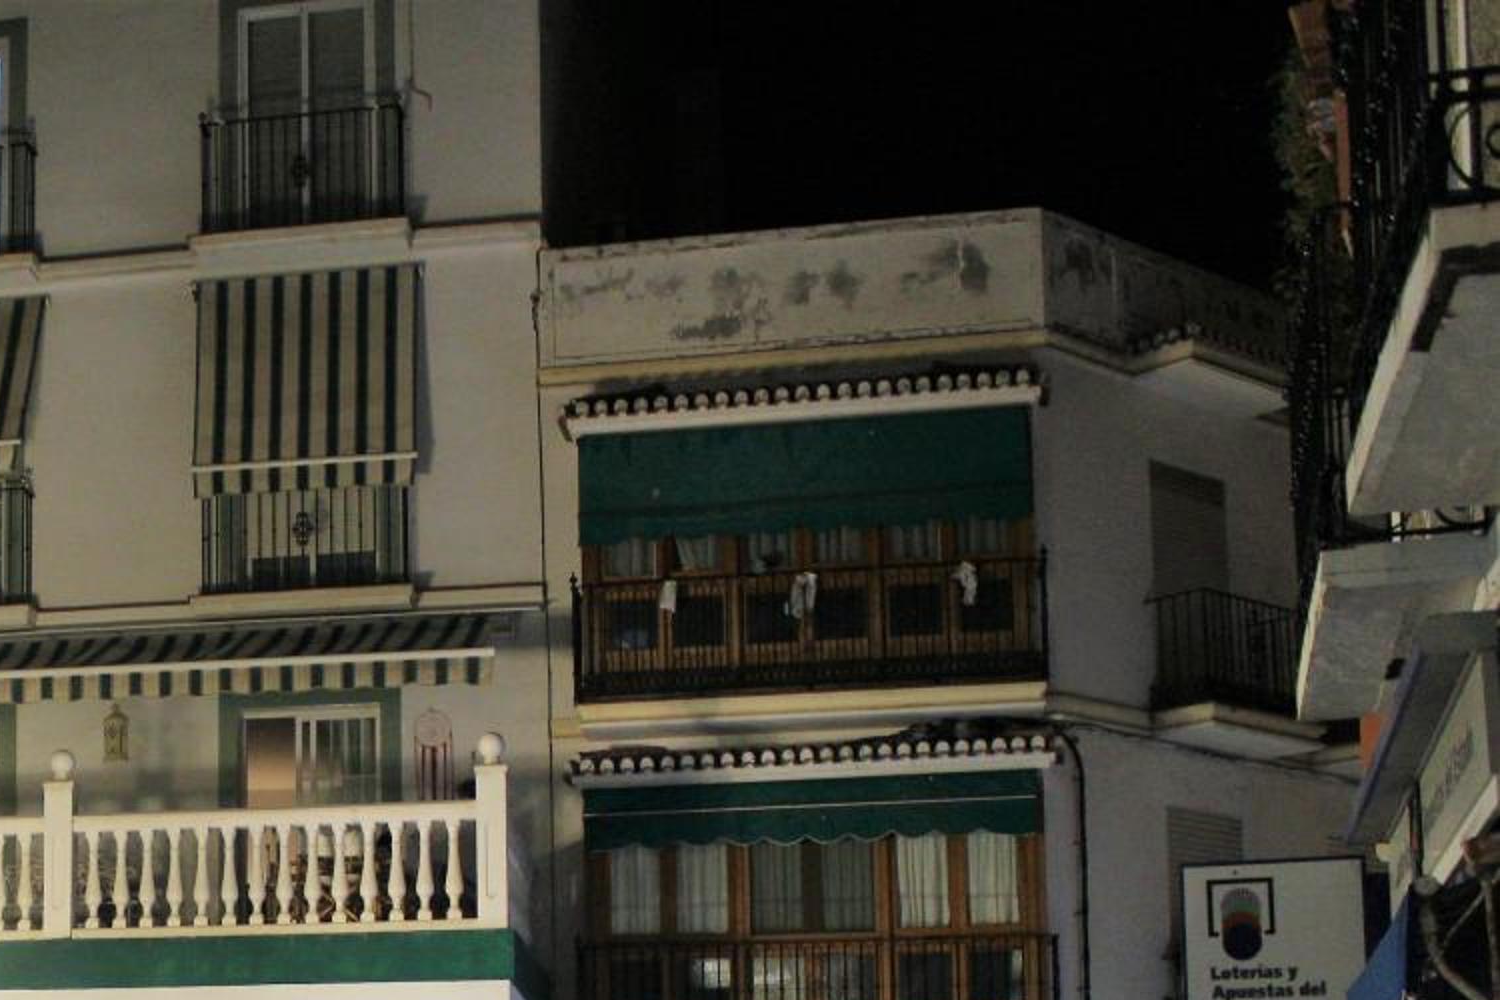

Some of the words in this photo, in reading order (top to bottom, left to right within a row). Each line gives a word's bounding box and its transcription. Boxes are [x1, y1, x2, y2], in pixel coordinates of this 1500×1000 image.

[1288, 966, 1298, 981] y
[1213, 984, 1294, 1000] Apuestas
[1299, 980, 1326, 996] del
